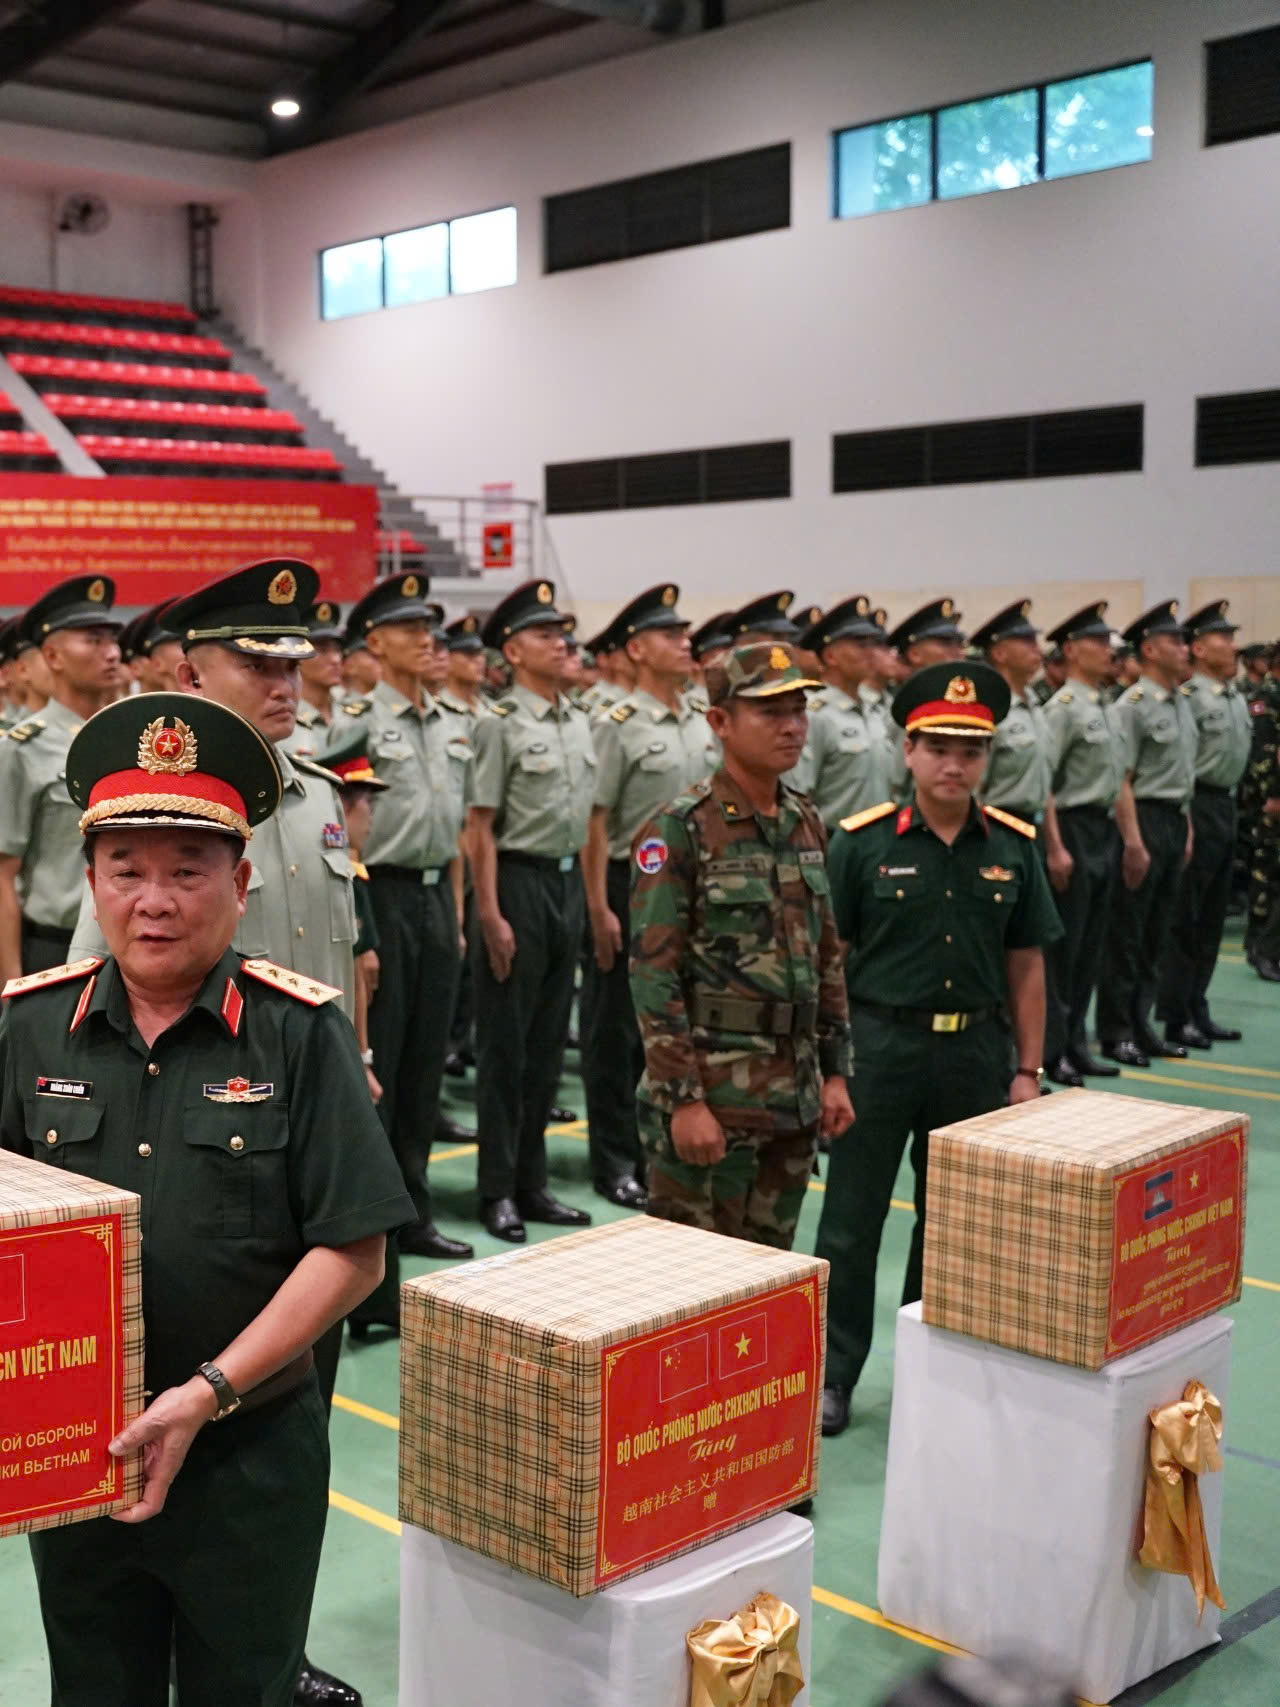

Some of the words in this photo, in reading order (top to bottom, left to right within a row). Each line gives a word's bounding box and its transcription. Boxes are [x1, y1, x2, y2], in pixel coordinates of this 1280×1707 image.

[21, 1338, 55, 1380] VIỆT
[59, 1335, 97, 1369] NAM
[26, 1420, 97, 1448] ОБОРОНЫ
[616, 1434, 631, 1466] BỘ
[633, 1421, 660, 1460] QUỐC
[662, 1414, 695, 1447] PHÒNG
[697, 1400, 723, 1433] NƯỚC
[725, 1387, 761, 1421] CHXHCN
[762, 1376, 782, 1408] VIỆT
[783, 1370, 806, 1399] NAM
[24, 1449, 90, 1475] ВЬЕТНАМ
[688, 1434, 737, 1464] Tặng
[623, 1438, 795, 1525] 越南社会主义共和国国防部
